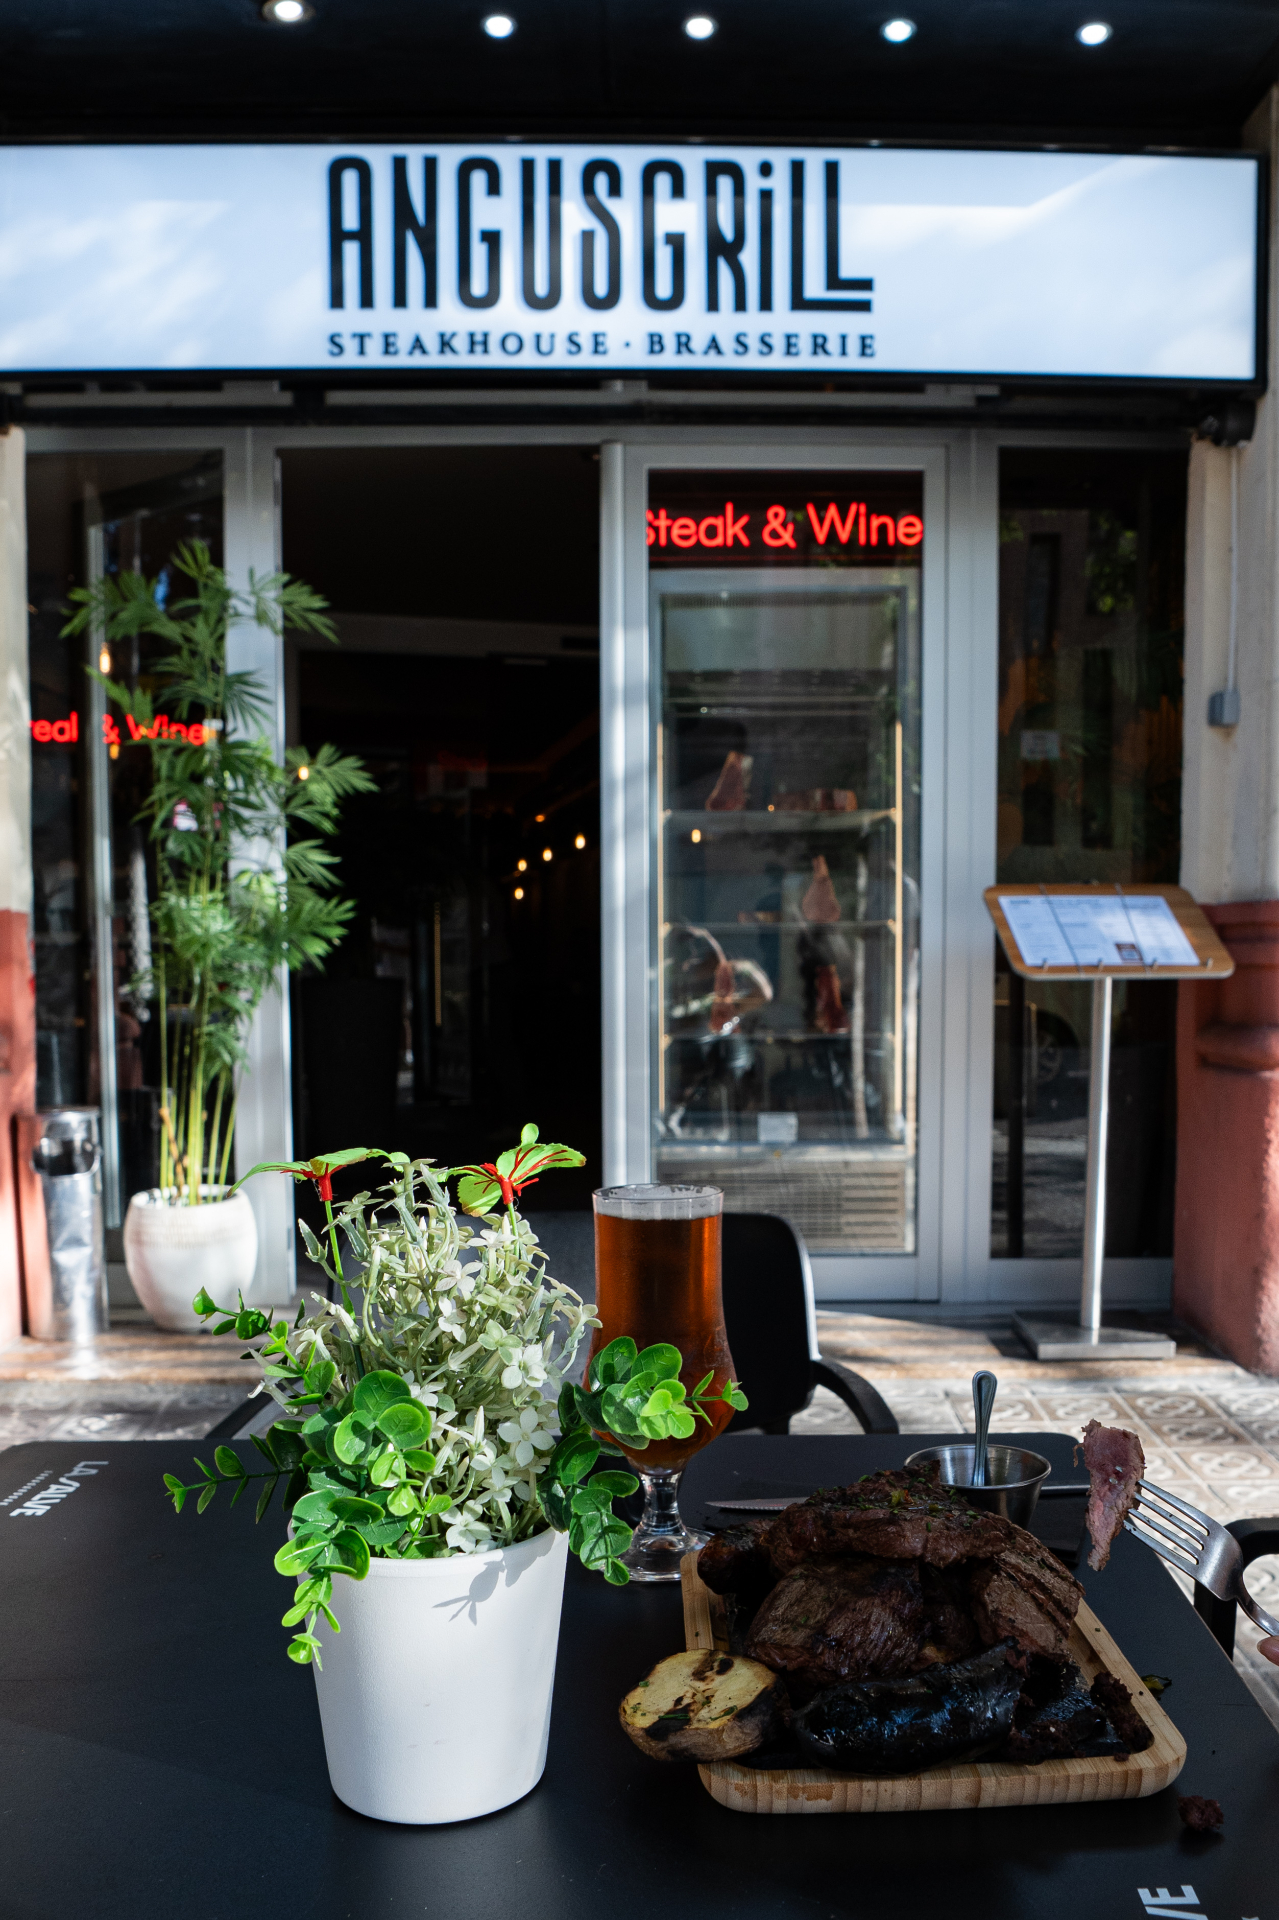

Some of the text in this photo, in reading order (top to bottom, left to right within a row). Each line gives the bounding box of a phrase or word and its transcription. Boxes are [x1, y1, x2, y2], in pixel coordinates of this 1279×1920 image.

[328, 331, 876, 359] STEAKHOUSE BRASSERIE
[761, 504, 798, 549] &
[806, 501, 924, 547] Wine
